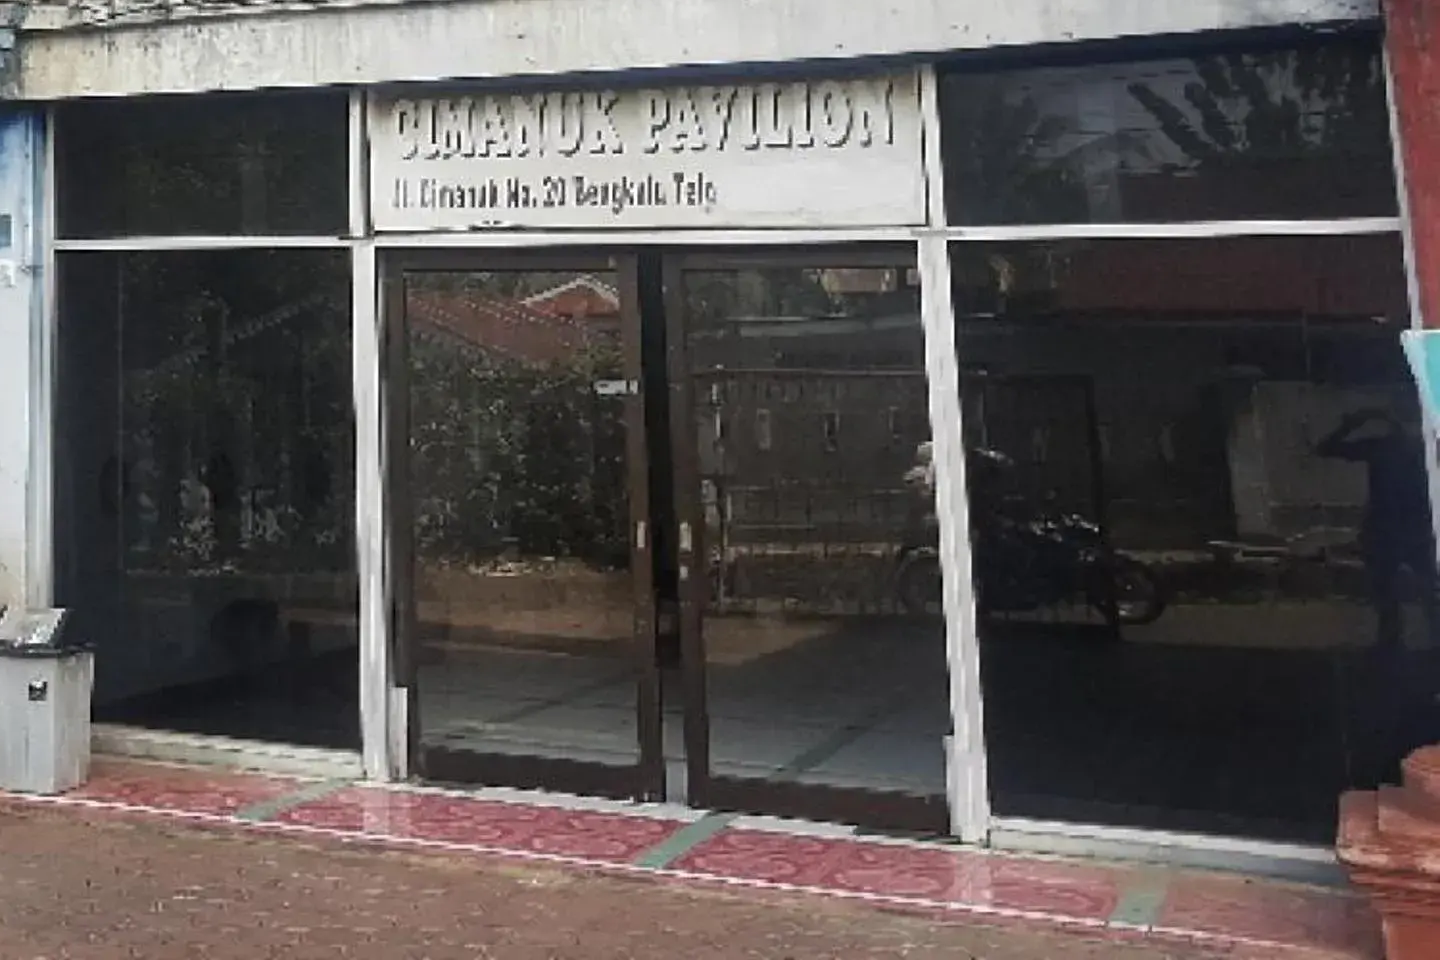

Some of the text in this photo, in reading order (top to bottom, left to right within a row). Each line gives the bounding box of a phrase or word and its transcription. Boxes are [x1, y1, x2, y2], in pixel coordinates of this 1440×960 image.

[391, 79, 895, 160] CIMANUK PAVILION
[574, 175, 667, 215] Bengkulu
